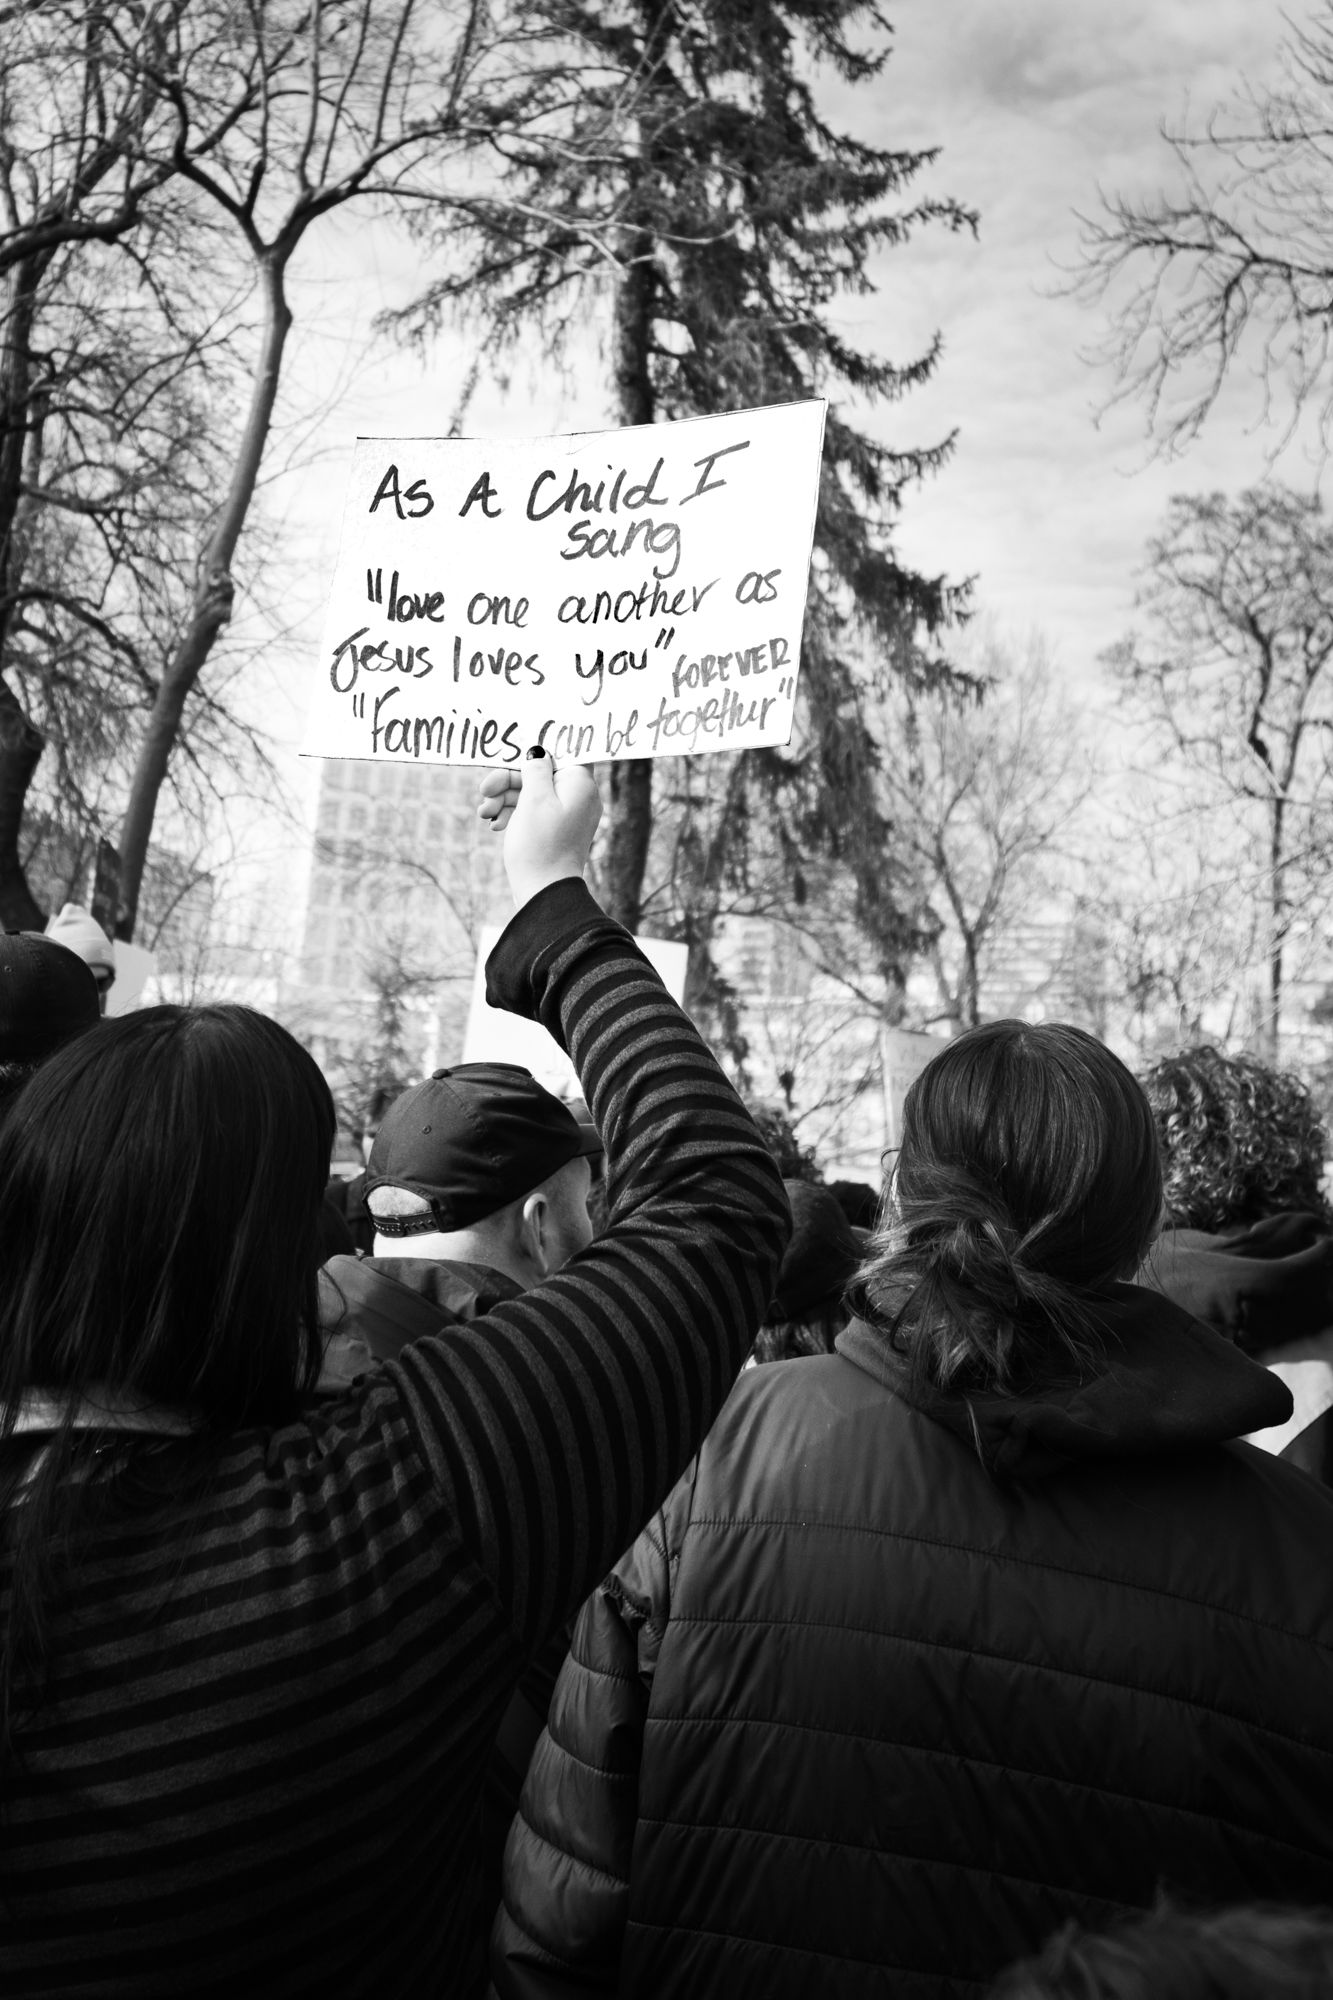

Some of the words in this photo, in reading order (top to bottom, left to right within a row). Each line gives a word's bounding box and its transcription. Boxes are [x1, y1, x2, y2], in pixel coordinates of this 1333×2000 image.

[368, 465, 435, 520] As
[458, 472, 504, 519] A
[527, 457, 669, 521] Child
[680, 441, 750, 506] I
[560, 517, 683, 580] sang
[467, 591, 529, 628] one
[556, 576, 722, 626] another
[734, 568, 783, 605] as
[329, 626, 434, 694] Jesus
[453, 635, 547, 687] loves
[605, 709, 638, 758] be
